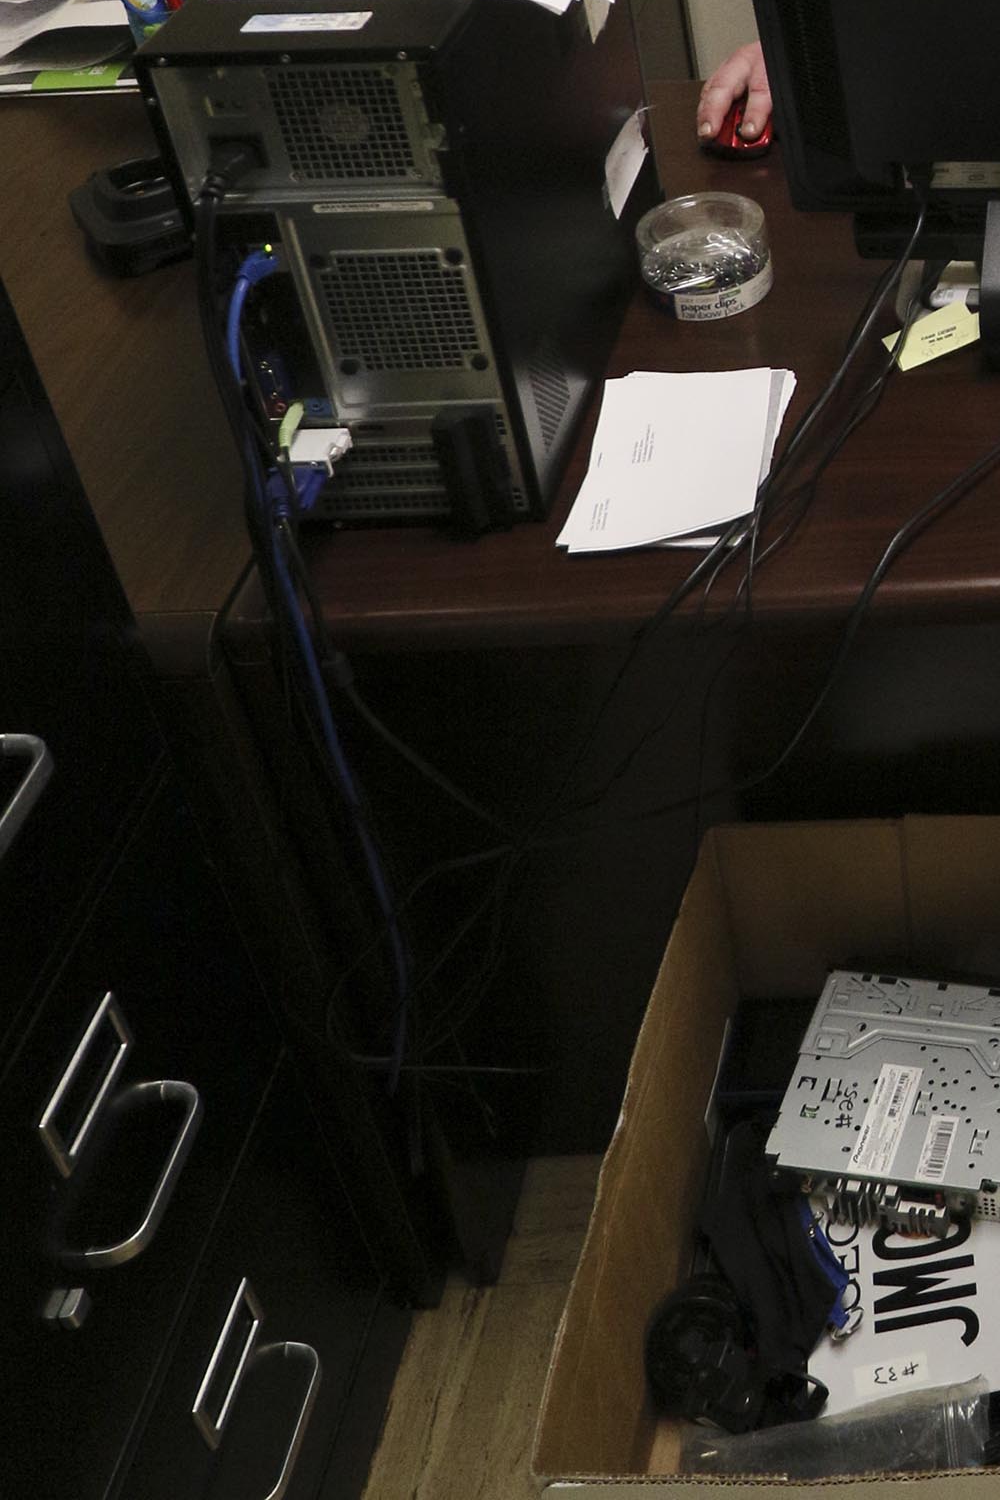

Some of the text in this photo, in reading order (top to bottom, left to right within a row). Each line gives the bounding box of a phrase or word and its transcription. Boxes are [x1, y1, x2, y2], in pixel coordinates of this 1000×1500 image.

[680, 297, 737, 313] paper clips
[724, 303, 746, 317] pack
[852, 1125, 872, 1164] Pioneer
